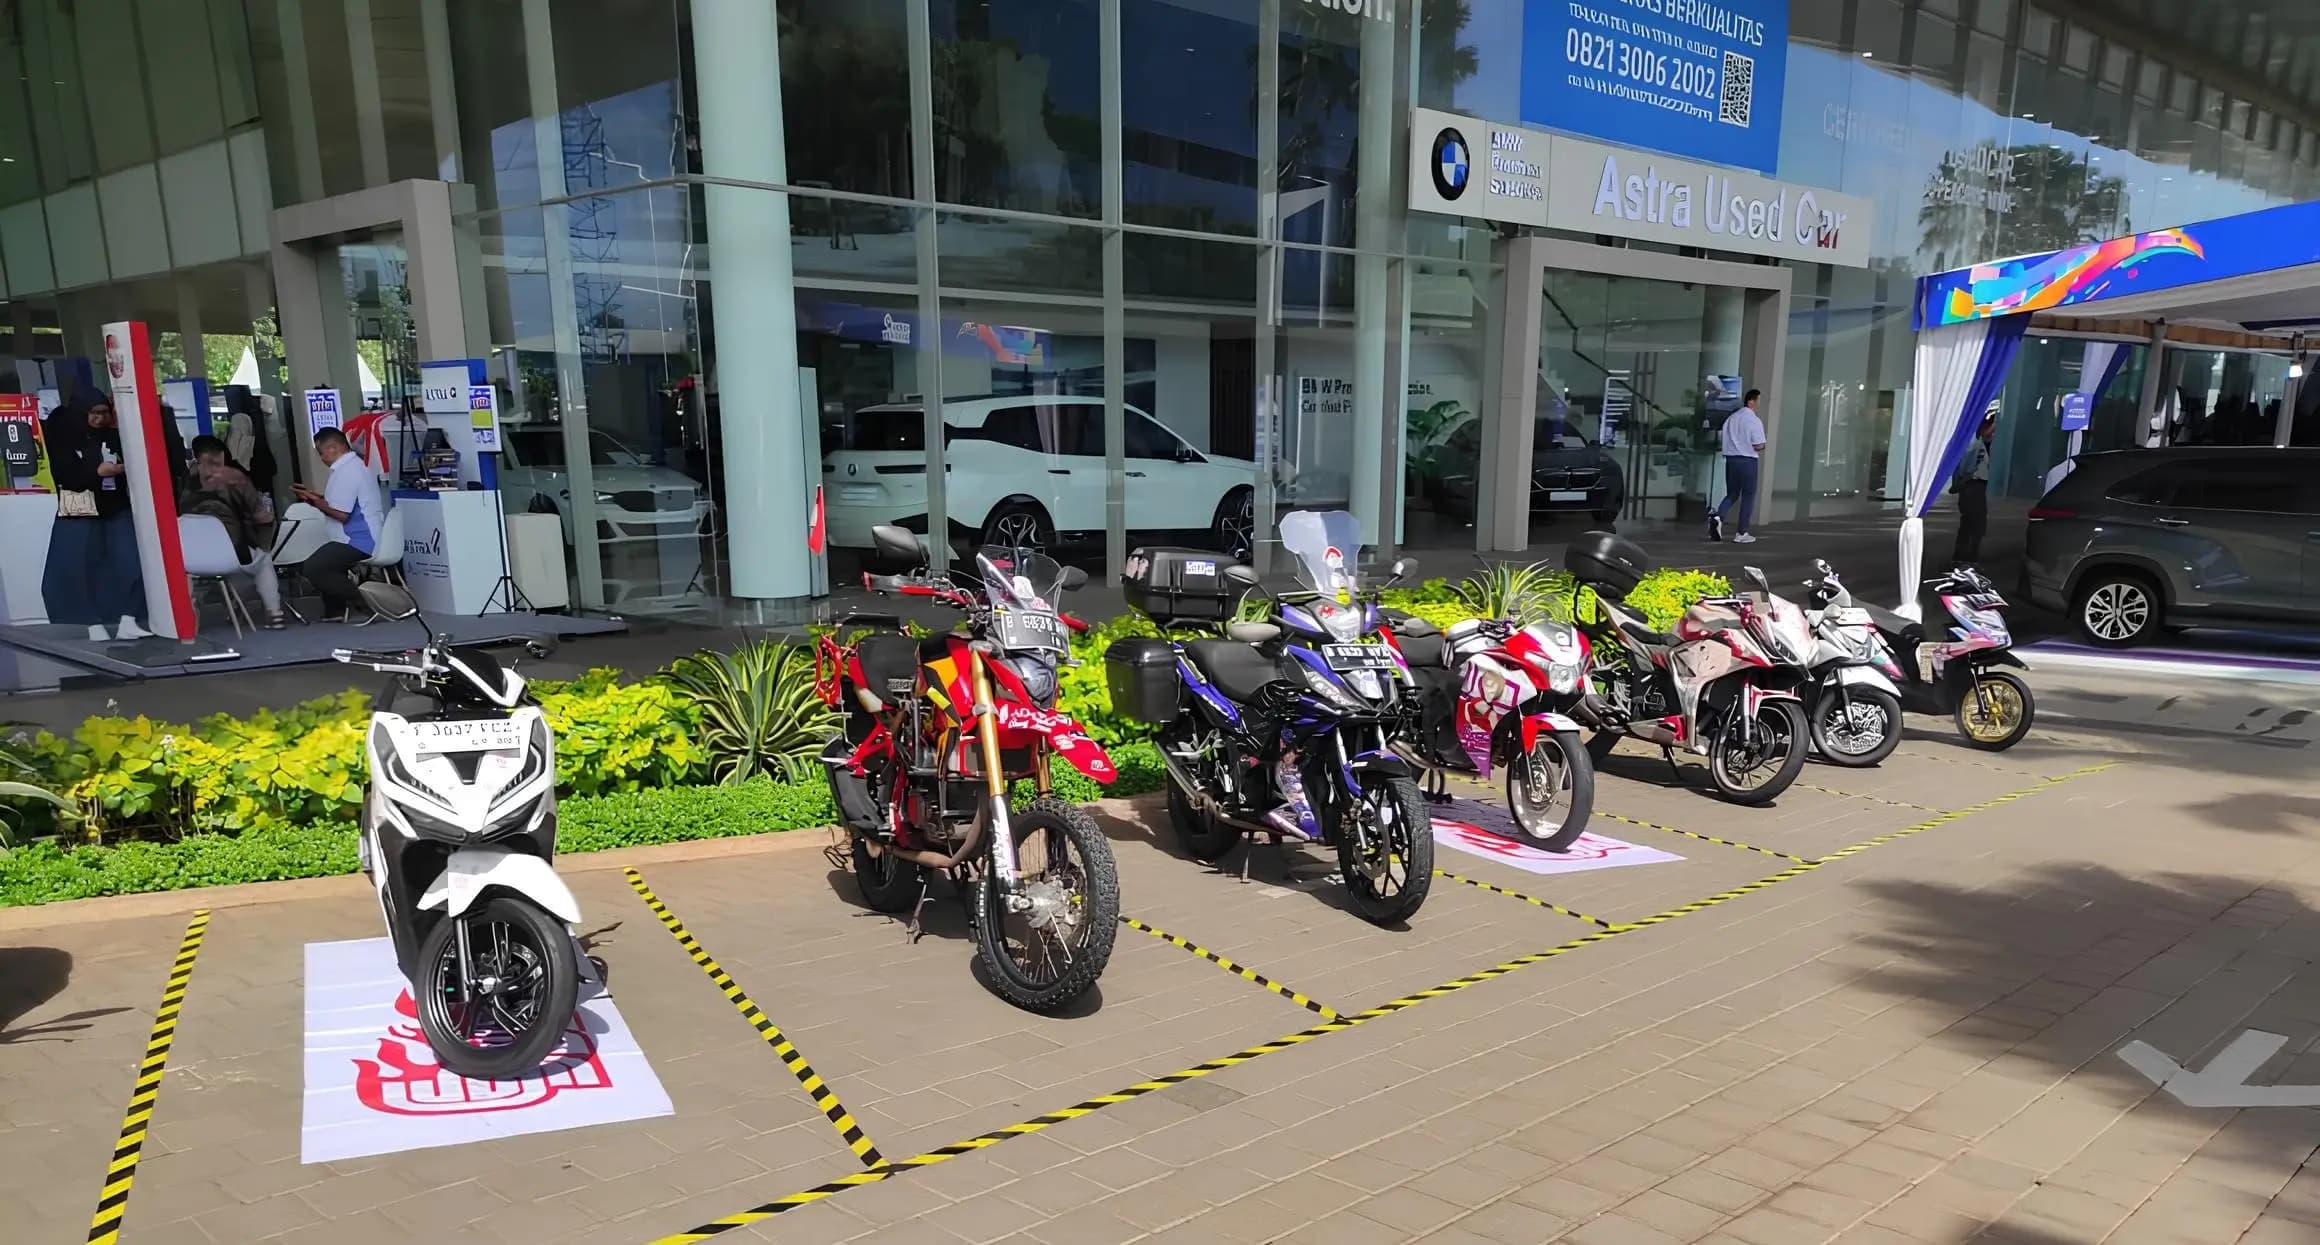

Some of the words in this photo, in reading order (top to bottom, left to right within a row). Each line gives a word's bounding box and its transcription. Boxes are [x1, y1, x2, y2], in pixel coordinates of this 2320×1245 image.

[1665, 0, 1765, 46] BERKUALITAS
[1566, 28, 1614, 72] 0821
[1617, 43, 1668, 86] 3006
[1671, 57, 1716, 99] 2002
[1592, 154, 1691, 229] Astra
[1703, 174, 1787, 243] Used
[1794, 189, 1848, 250] Car
